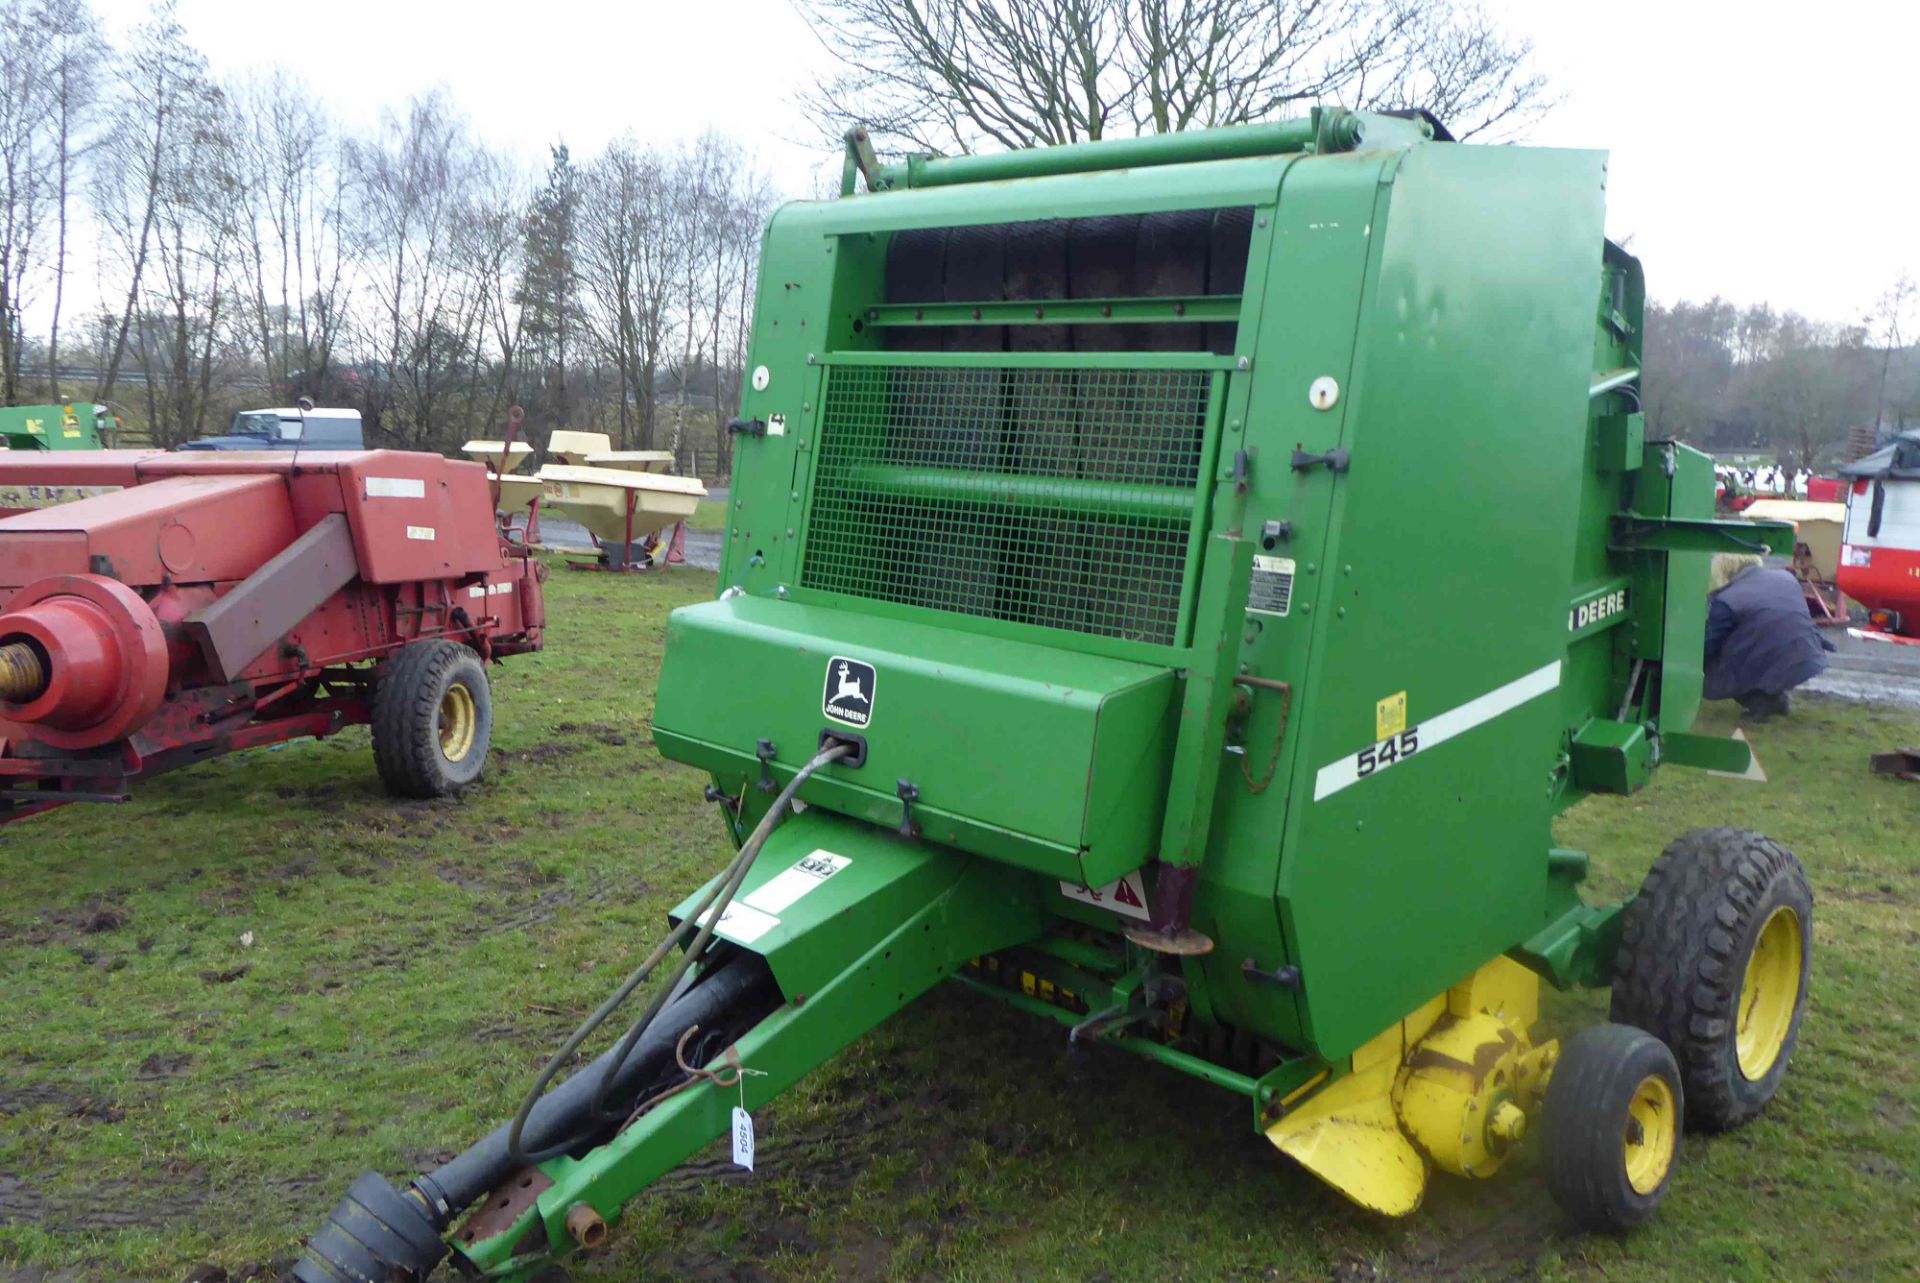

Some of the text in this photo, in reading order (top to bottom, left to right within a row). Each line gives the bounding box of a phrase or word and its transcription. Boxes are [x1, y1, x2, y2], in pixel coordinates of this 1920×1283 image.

[1577, 590, 1625, 628] DEERE
[825, 703, 868, 723] JOHN DEERE
[1357, 726, 1418, 778] 545
[739, 1123, 749, 1154] 4504
